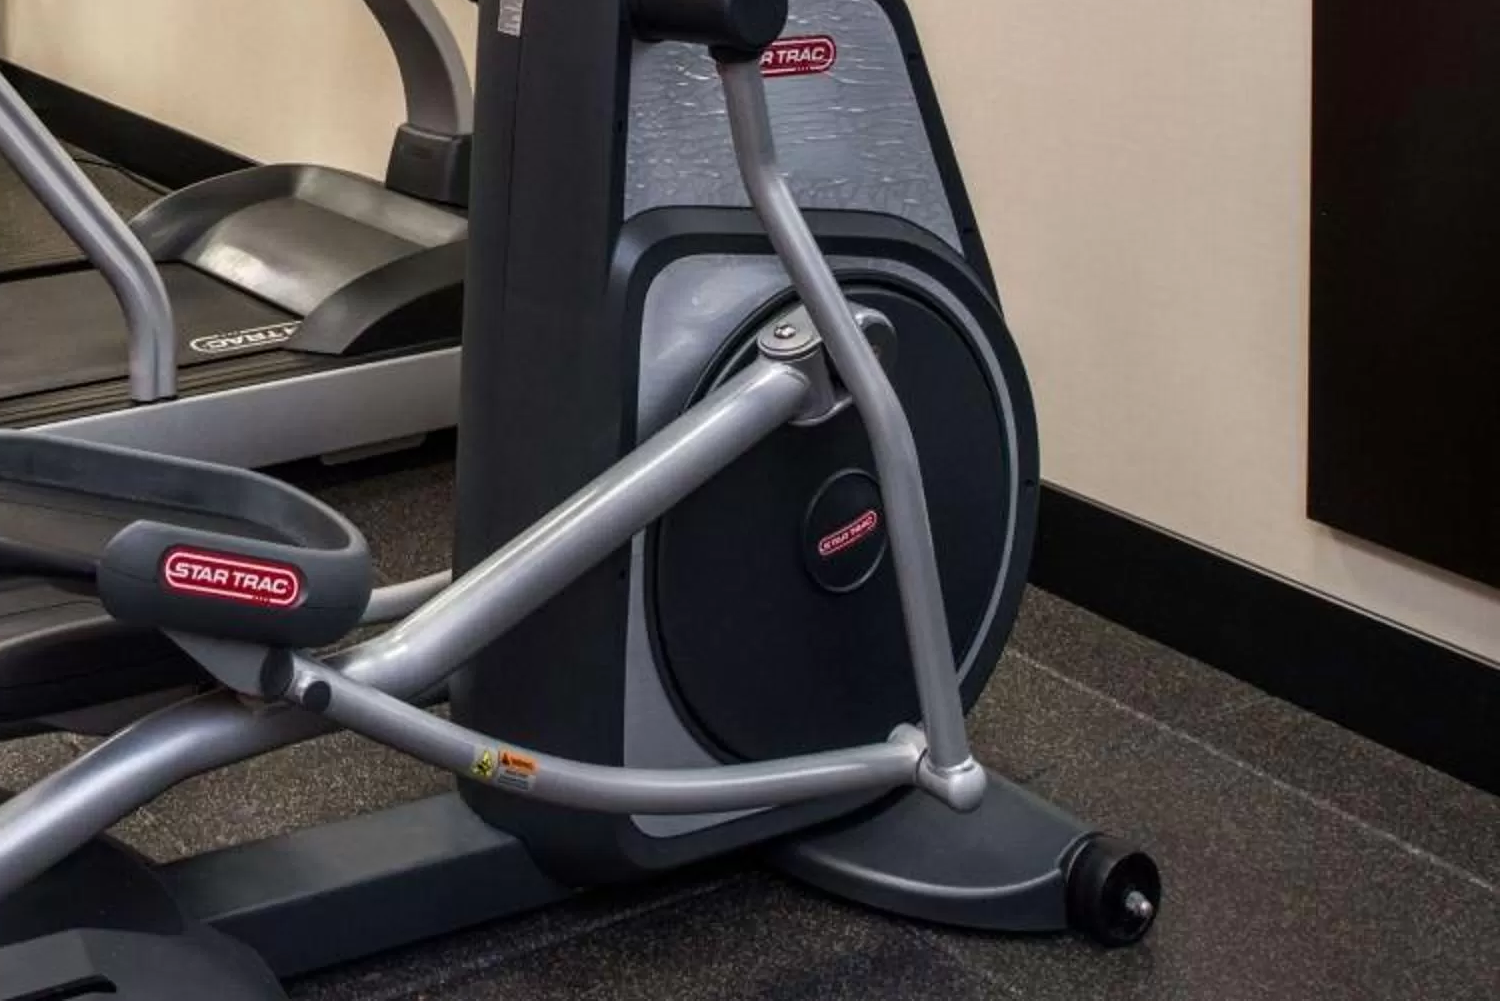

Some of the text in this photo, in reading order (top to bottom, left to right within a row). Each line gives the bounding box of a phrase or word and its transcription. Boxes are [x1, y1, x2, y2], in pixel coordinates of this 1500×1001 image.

[776, 46, 826, 65] TRAC
[174, 562, 289, 595] STAR TRAC
